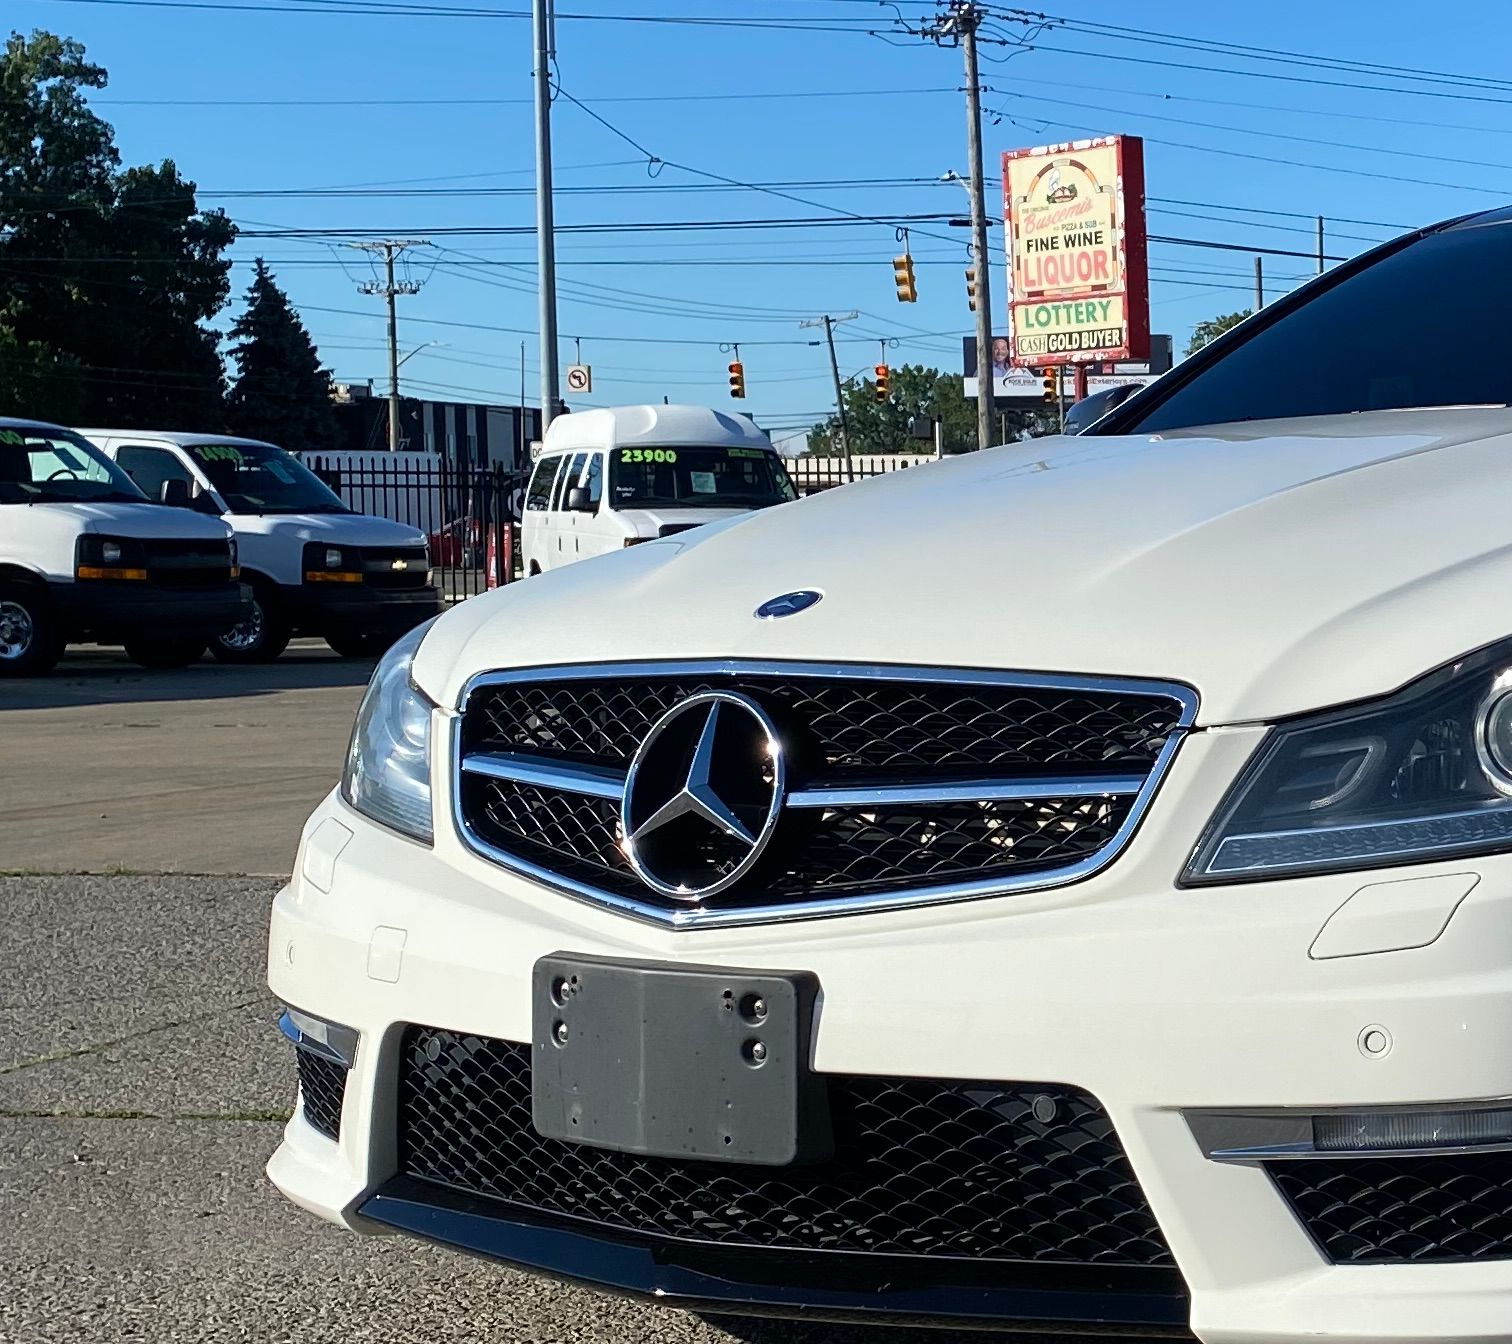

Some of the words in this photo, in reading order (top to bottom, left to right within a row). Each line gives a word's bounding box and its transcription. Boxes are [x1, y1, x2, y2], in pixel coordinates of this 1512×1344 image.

[1026, 236, 1060, 253] FINE
[1064, 230, 1104, 249] WINE
[1023, 250, 1110, 288] LIQUOR
[1024, 300, 1112, 329] LOTTERY
[1020, 336, 1047, 353] CASH
[1048, 332, 1080, 352] GOLD
[1081, 328, 1121, 349] BUYER
[621, 448, 677, 464] 23900
